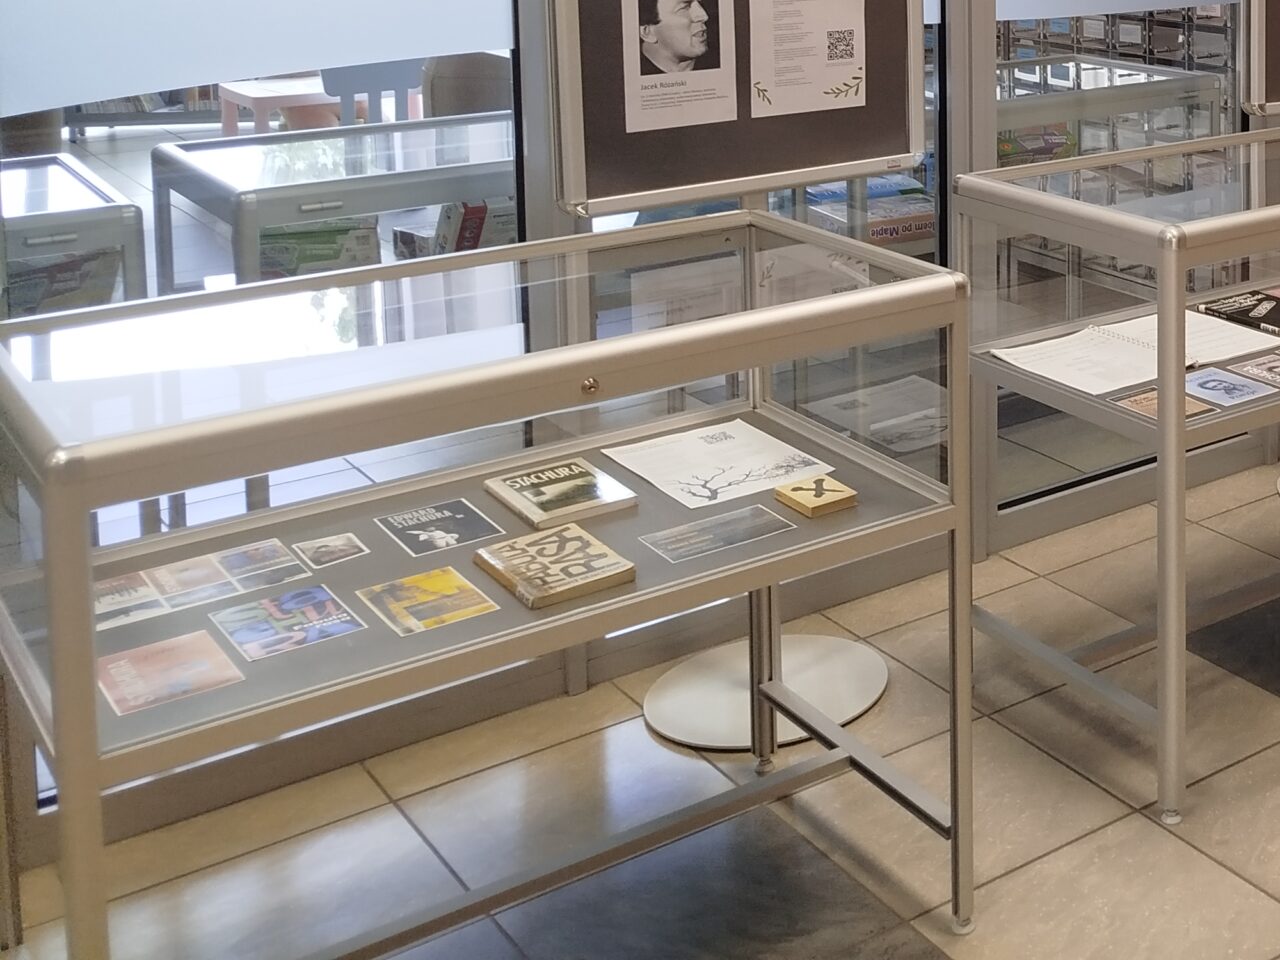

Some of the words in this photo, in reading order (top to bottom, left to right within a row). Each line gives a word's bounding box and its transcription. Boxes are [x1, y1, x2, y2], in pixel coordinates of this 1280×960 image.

[640, 83, 658, 91] Jacek
[503, 464, 586, 489] STACHURA
[387, 507, 436, 524] EDWARD
[393, 510, 454, 529] STACHURA
